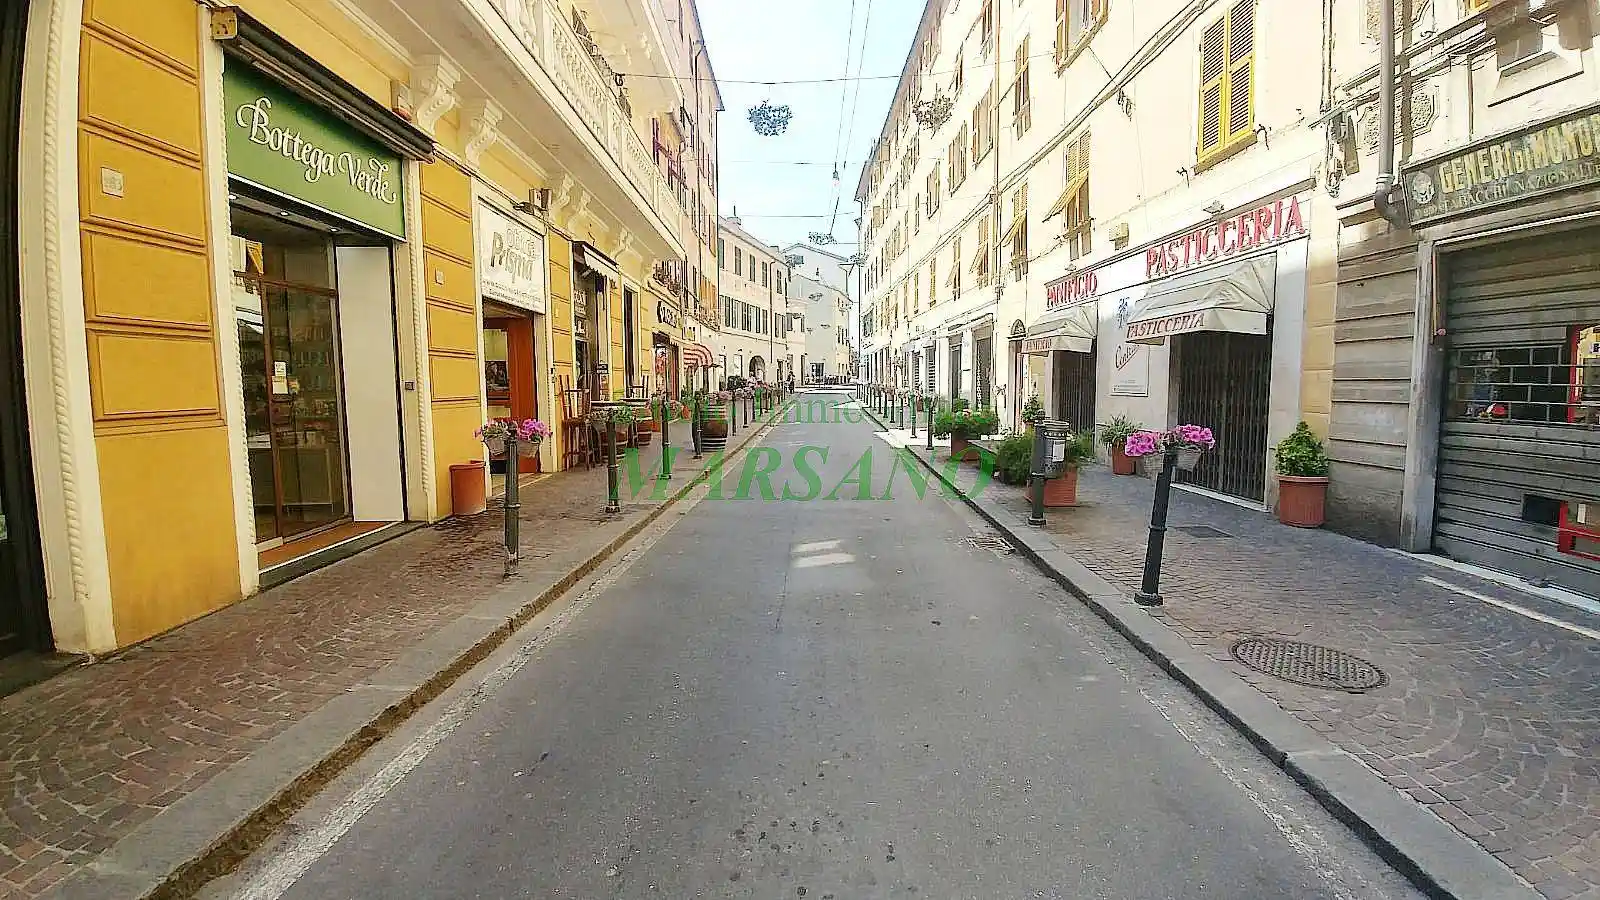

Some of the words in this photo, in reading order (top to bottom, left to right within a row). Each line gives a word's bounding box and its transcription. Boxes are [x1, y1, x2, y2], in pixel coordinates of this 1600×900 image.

[236, 97, 335, 183] Bottega
[337, 152, 397, 204] Verde
[1438, 140, 1514, 193] GENERI
[1145, 195, 1307, 279] PASTICCERIA
[1046, 272, 1098, 309] PANIFICIO
[1126, 312, 1206, 339] PASTICCERIA
